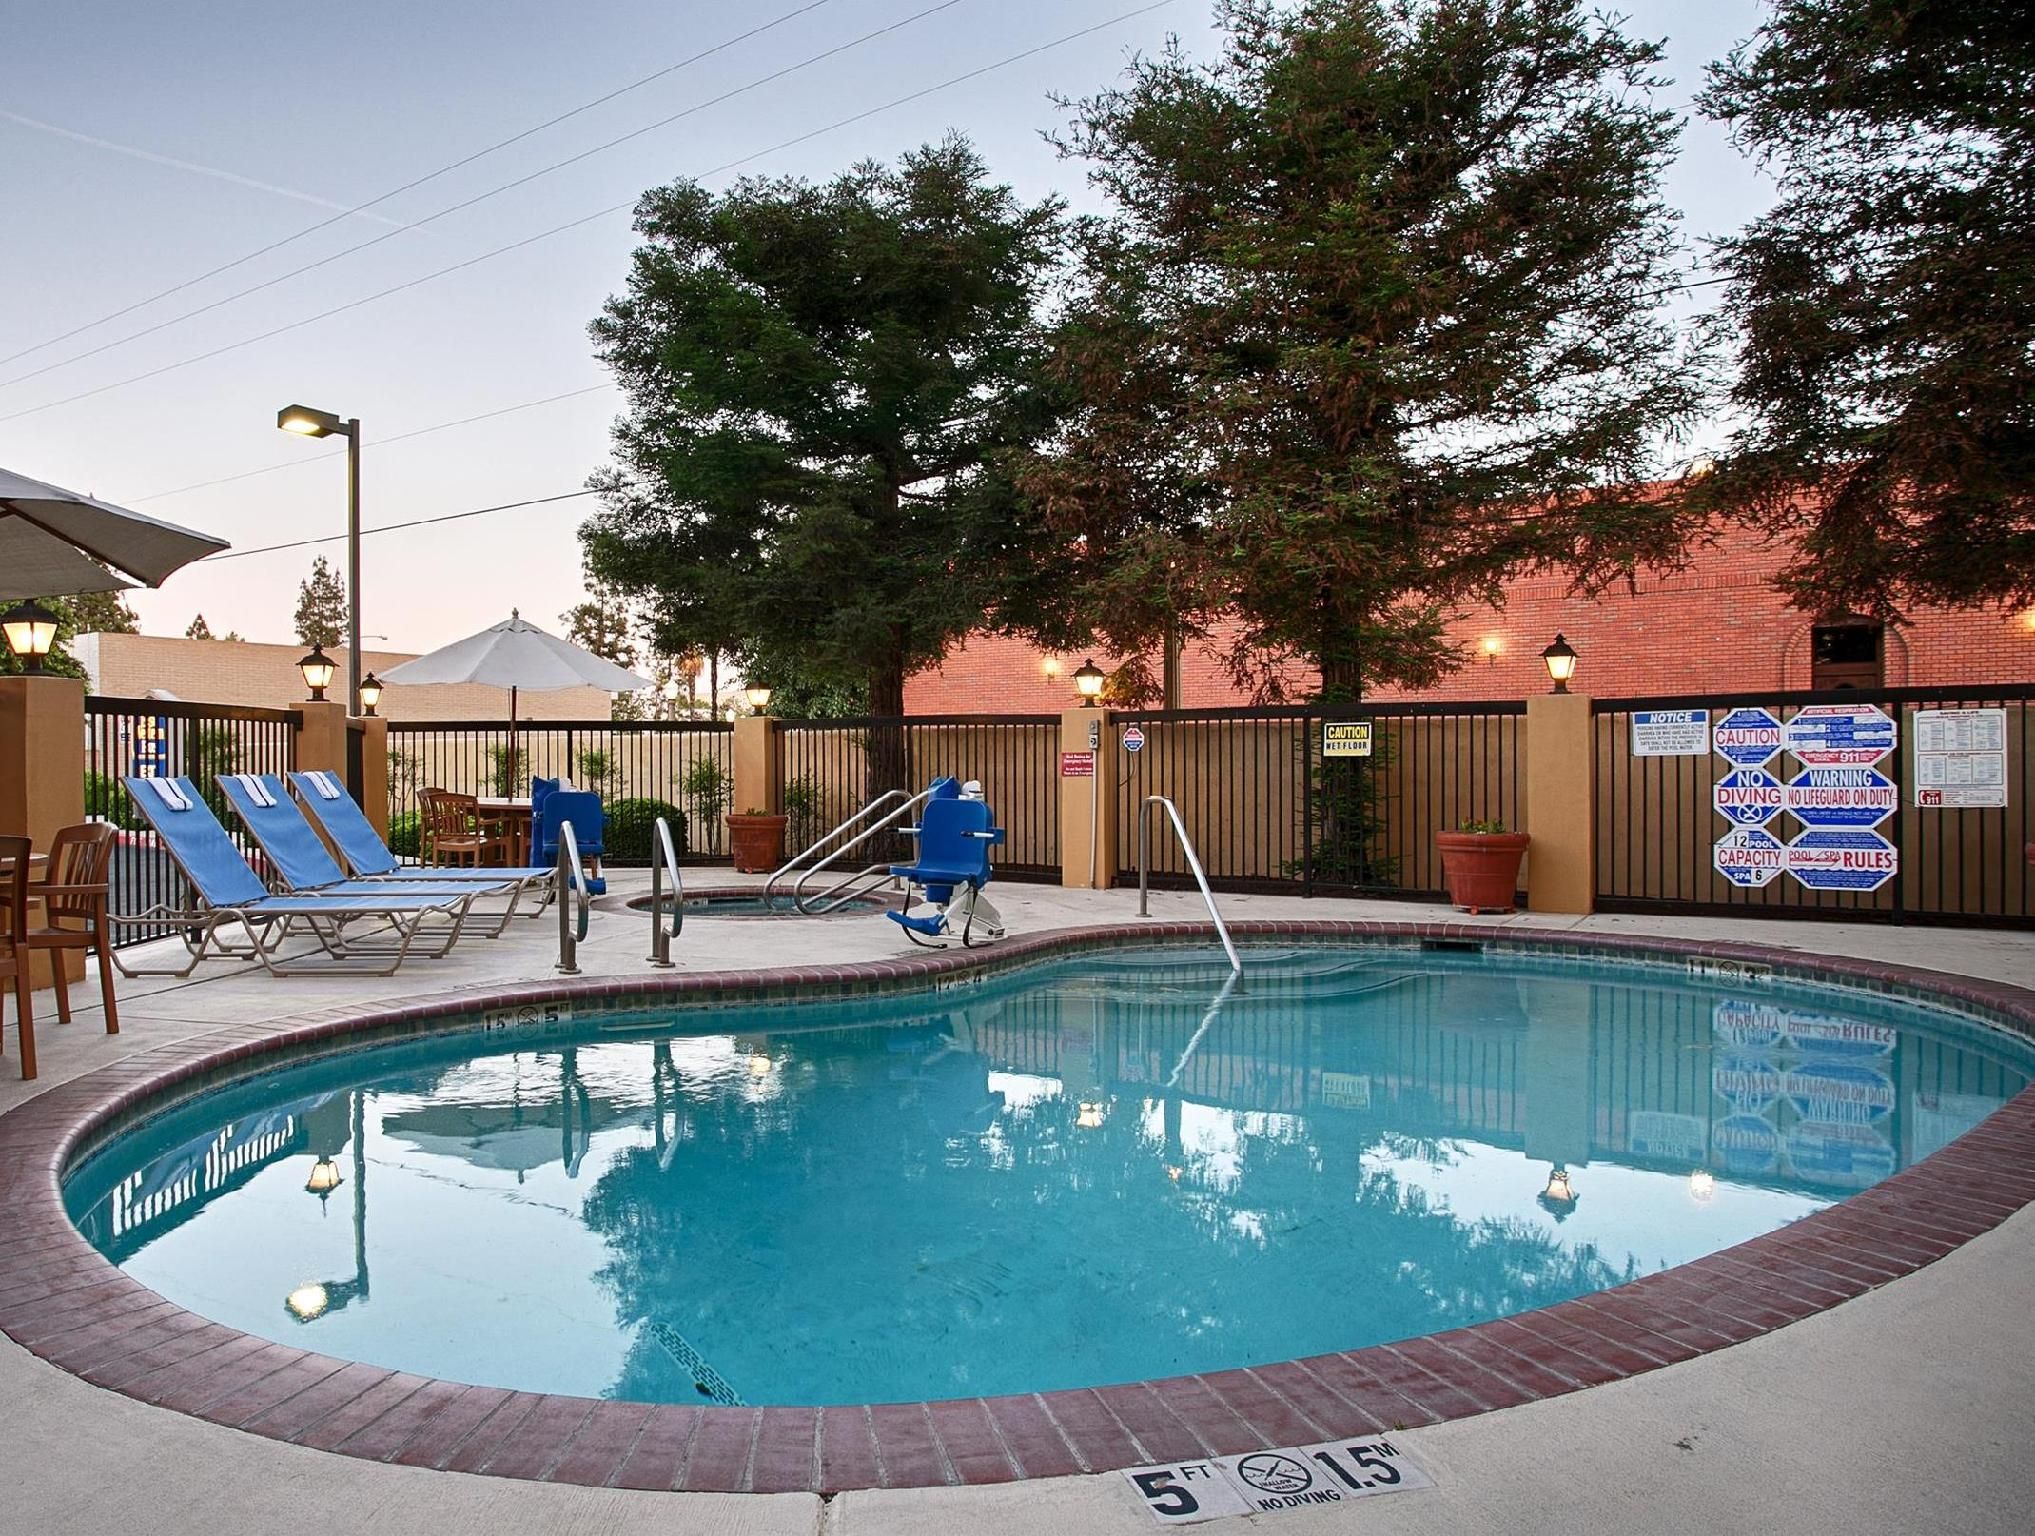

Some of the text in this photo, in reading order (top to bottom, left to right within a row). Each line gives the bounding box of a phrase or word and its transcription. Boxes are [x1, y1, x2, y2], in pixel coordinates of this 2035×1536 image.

[1650, 712, 1692, 723] NOTICE
[1328, 726, 1367, 738] CAUTION
[1715, 729, 1780, 745] CAUTION
[1327, 741, 1367, 749] WET FLOOR
[1840, 752, 1860, 762] 911
[1737, 771, 1764, 787] NO
[1809, 770, 1873, 786] WARNING
[1717, 788, 1781, 804] DIVING
[1788, 789, 1893, 805] NO LIFEGUARD ON DUTY
[1734, 835, 1747, 847] 12
[1749, 840, 1774, 848] POOL
[1718, 849, 1780, 866] CAPACITY
[1844, 852, 1893, 867] RULES
[1733, 872, 1751, 880] SPA
[1755, 869, 1763, 880] 6
[544, 1006, 559, 1023] 5
[1313, 1442, 1401, 1490] 1.5 M
[1131, 1464, 1211, 1516] 5 FT
[1258, 1478, 1292, 1487] SHALLOW
[1257, 1489, 1341, 1511] NO DIVING
